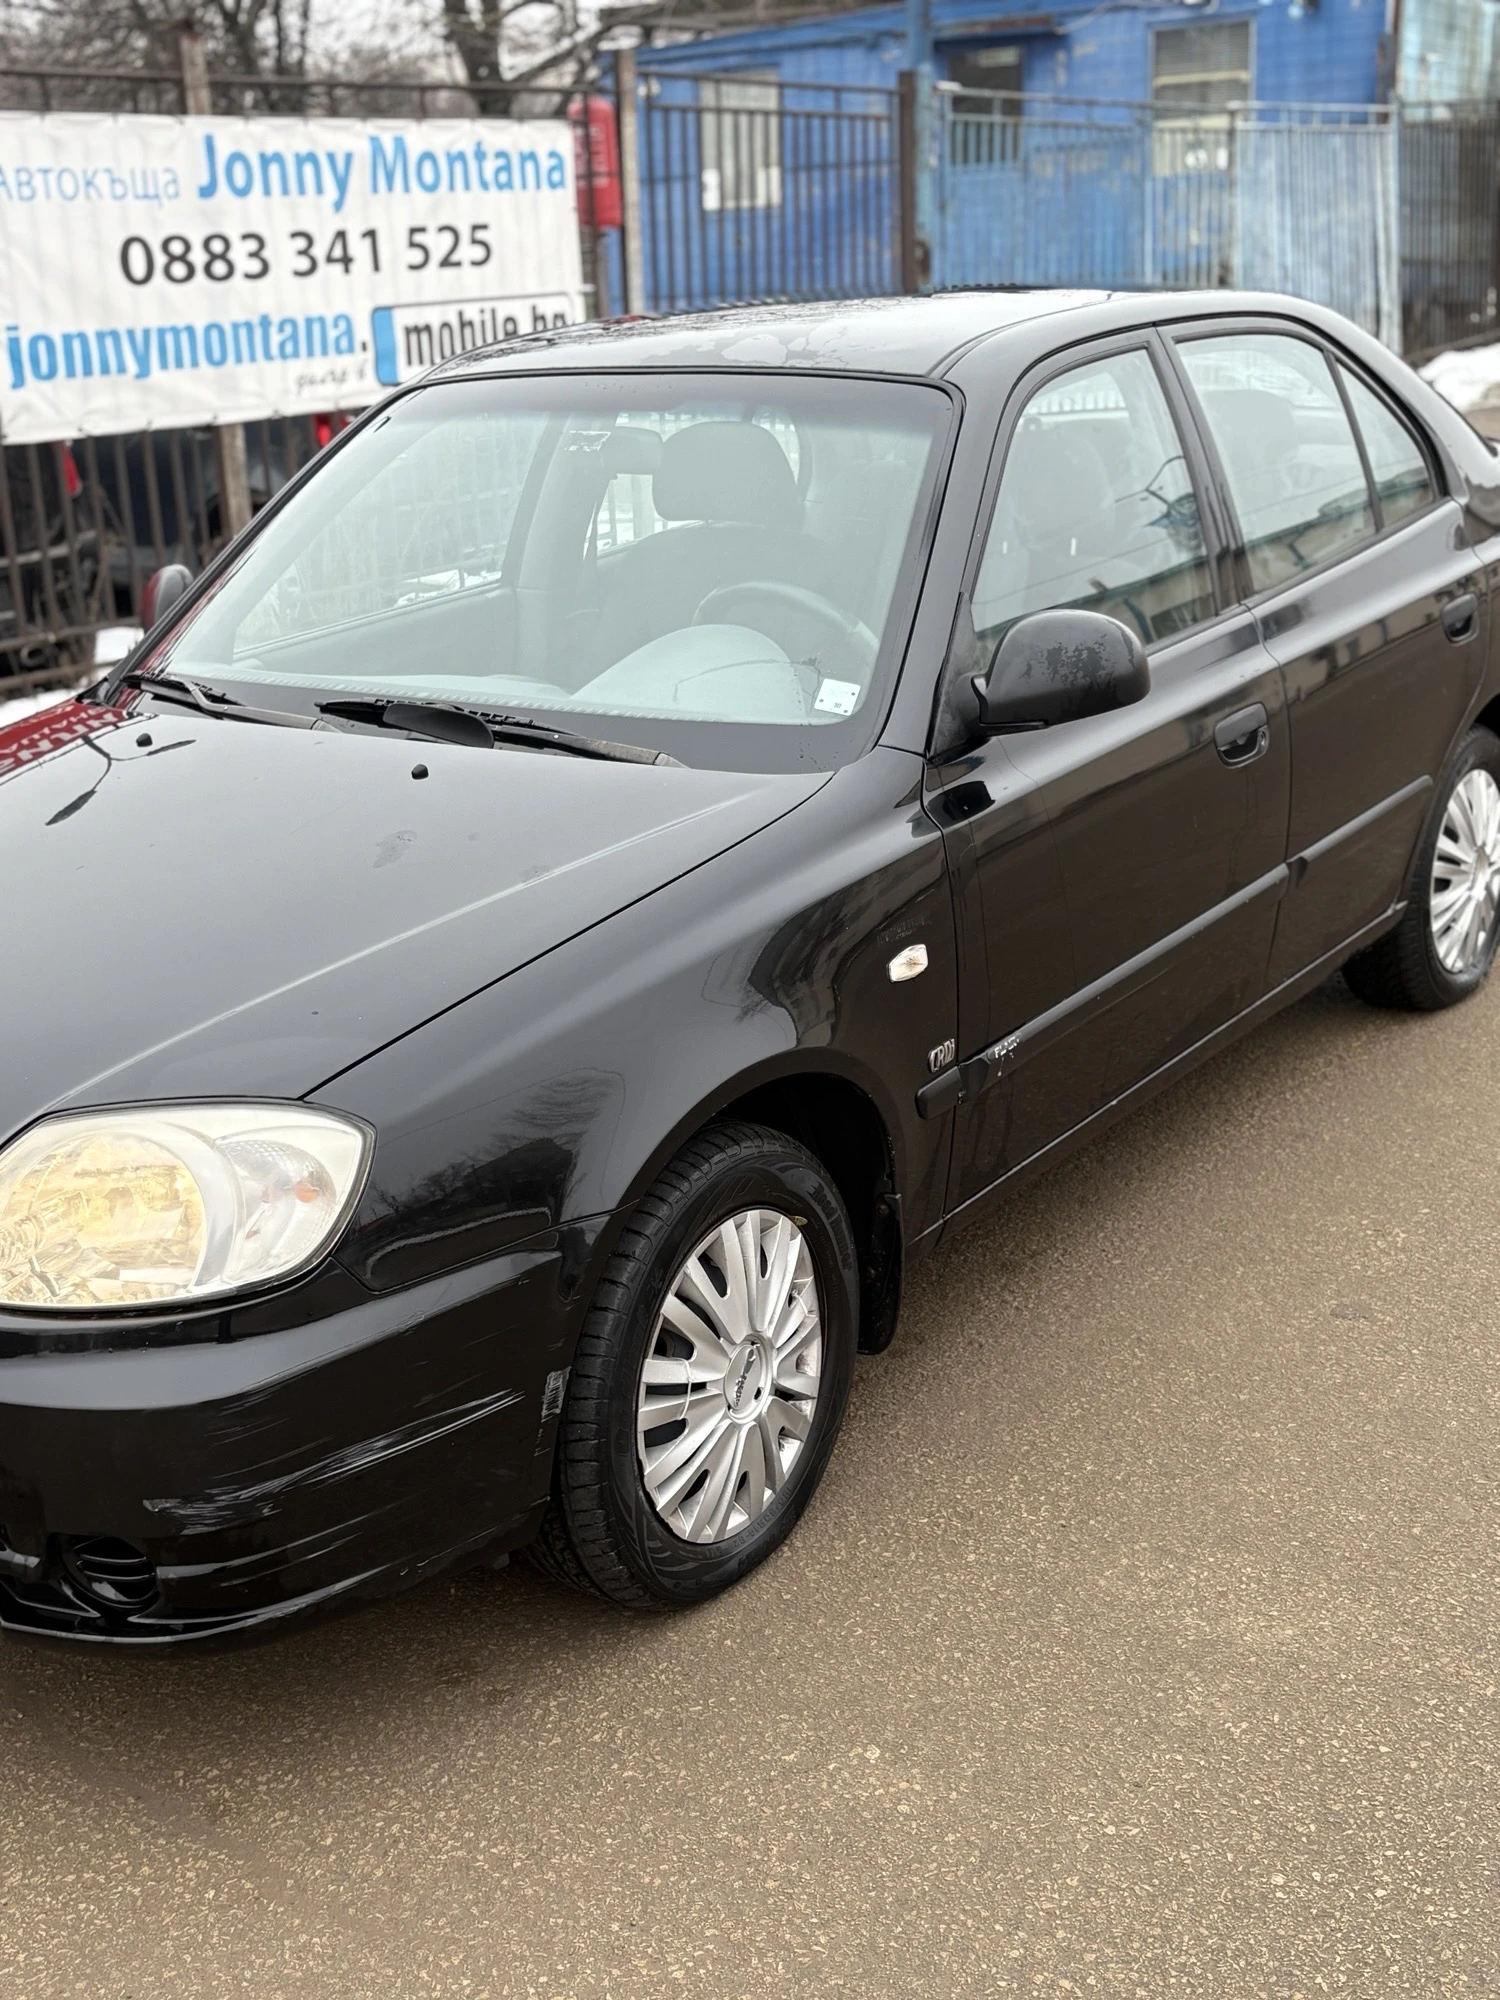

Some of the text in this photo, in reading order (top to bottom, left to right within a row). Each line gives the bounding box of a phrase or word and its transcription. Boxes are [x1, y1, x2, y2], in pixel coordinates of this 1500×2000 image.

[197, 134, 354, 213] Jonny
[368, 136, 567, 194] Montana
[119, 224, 492, 286] 0883 341 525
